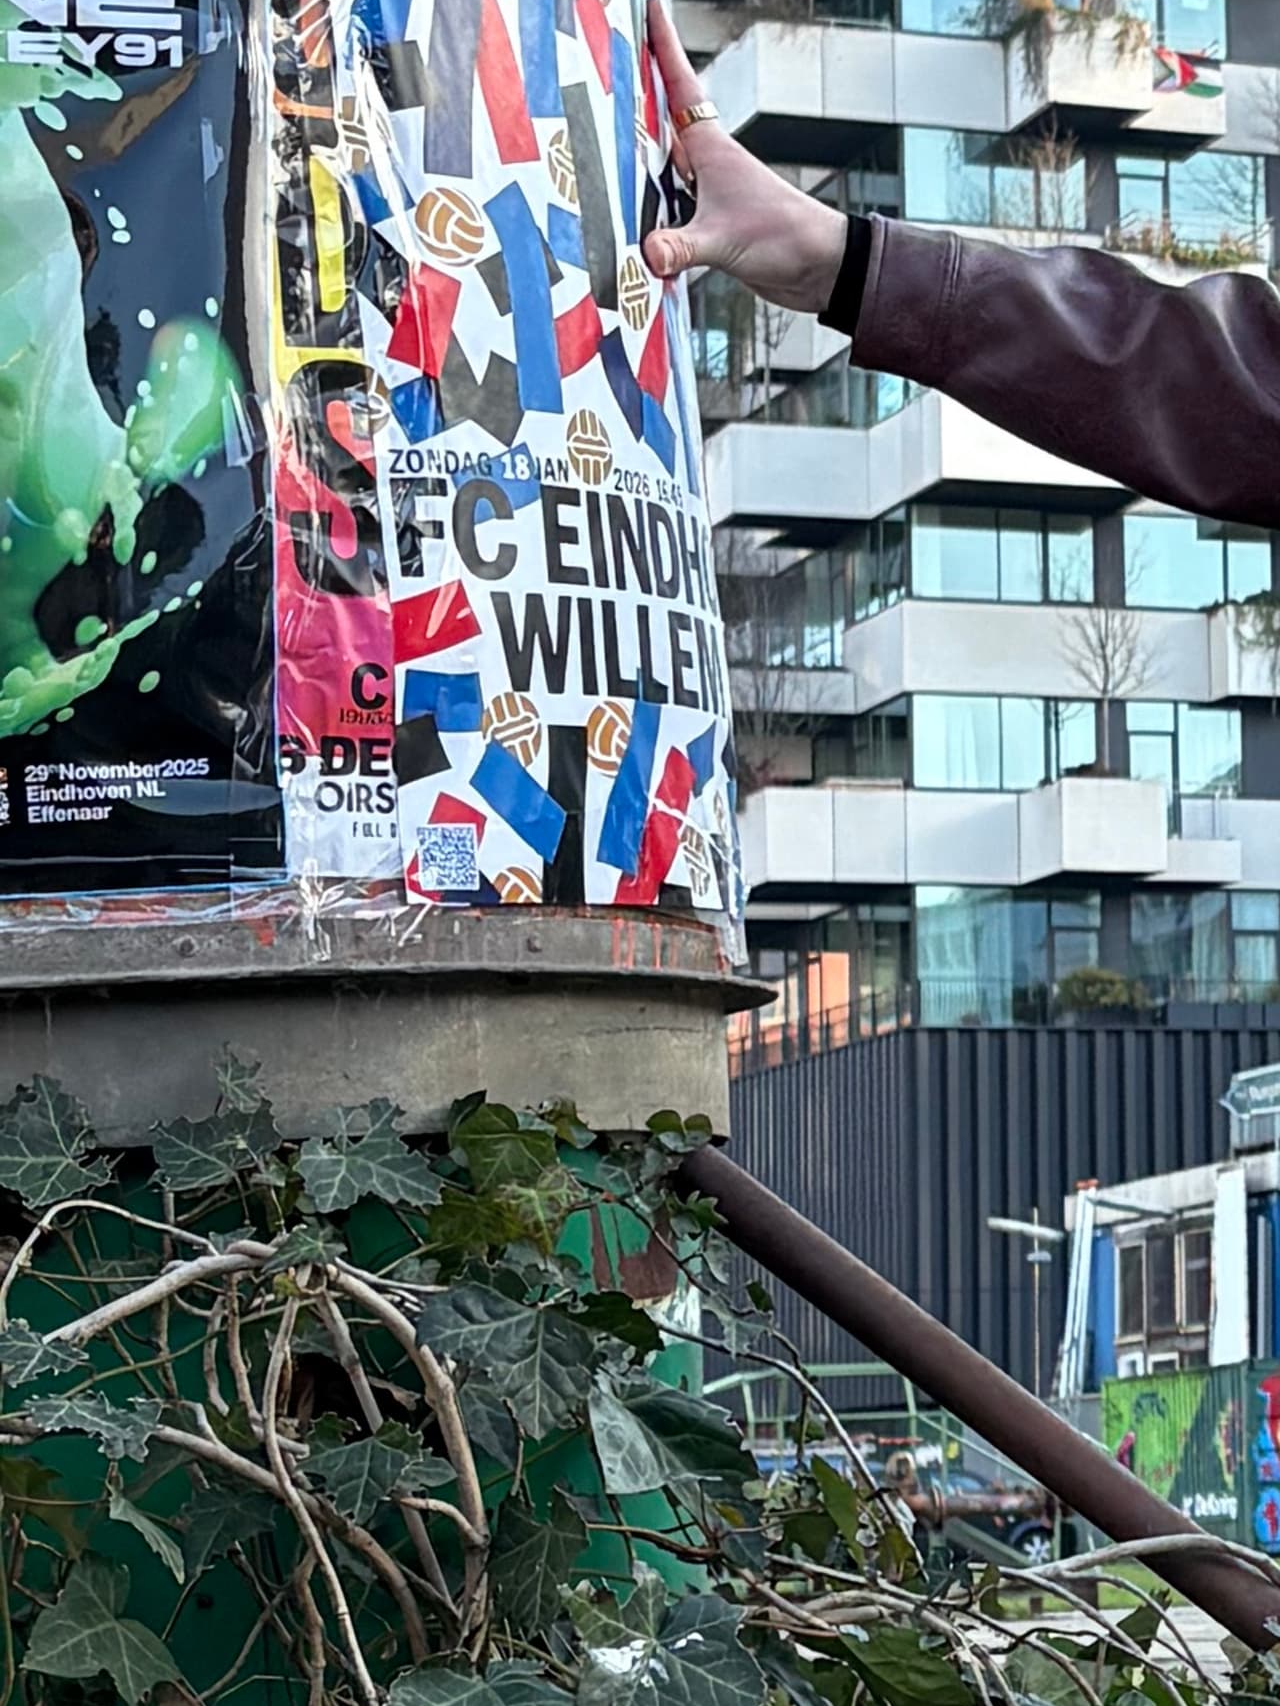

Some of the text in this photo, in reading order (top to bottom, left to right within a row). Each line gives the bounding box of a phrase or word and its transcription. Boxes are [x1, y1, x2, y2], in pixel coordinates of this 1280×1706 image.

[388, 448, 493, 476] ZONDAG
[501, 454, 533, 480] 18
[535, 457, 570, 483] JAN
[389, 477, 519, 581] FC
[26, 780, 166, 803] Eindhoven NL
[27, 805, 113, 824] Effenaar
